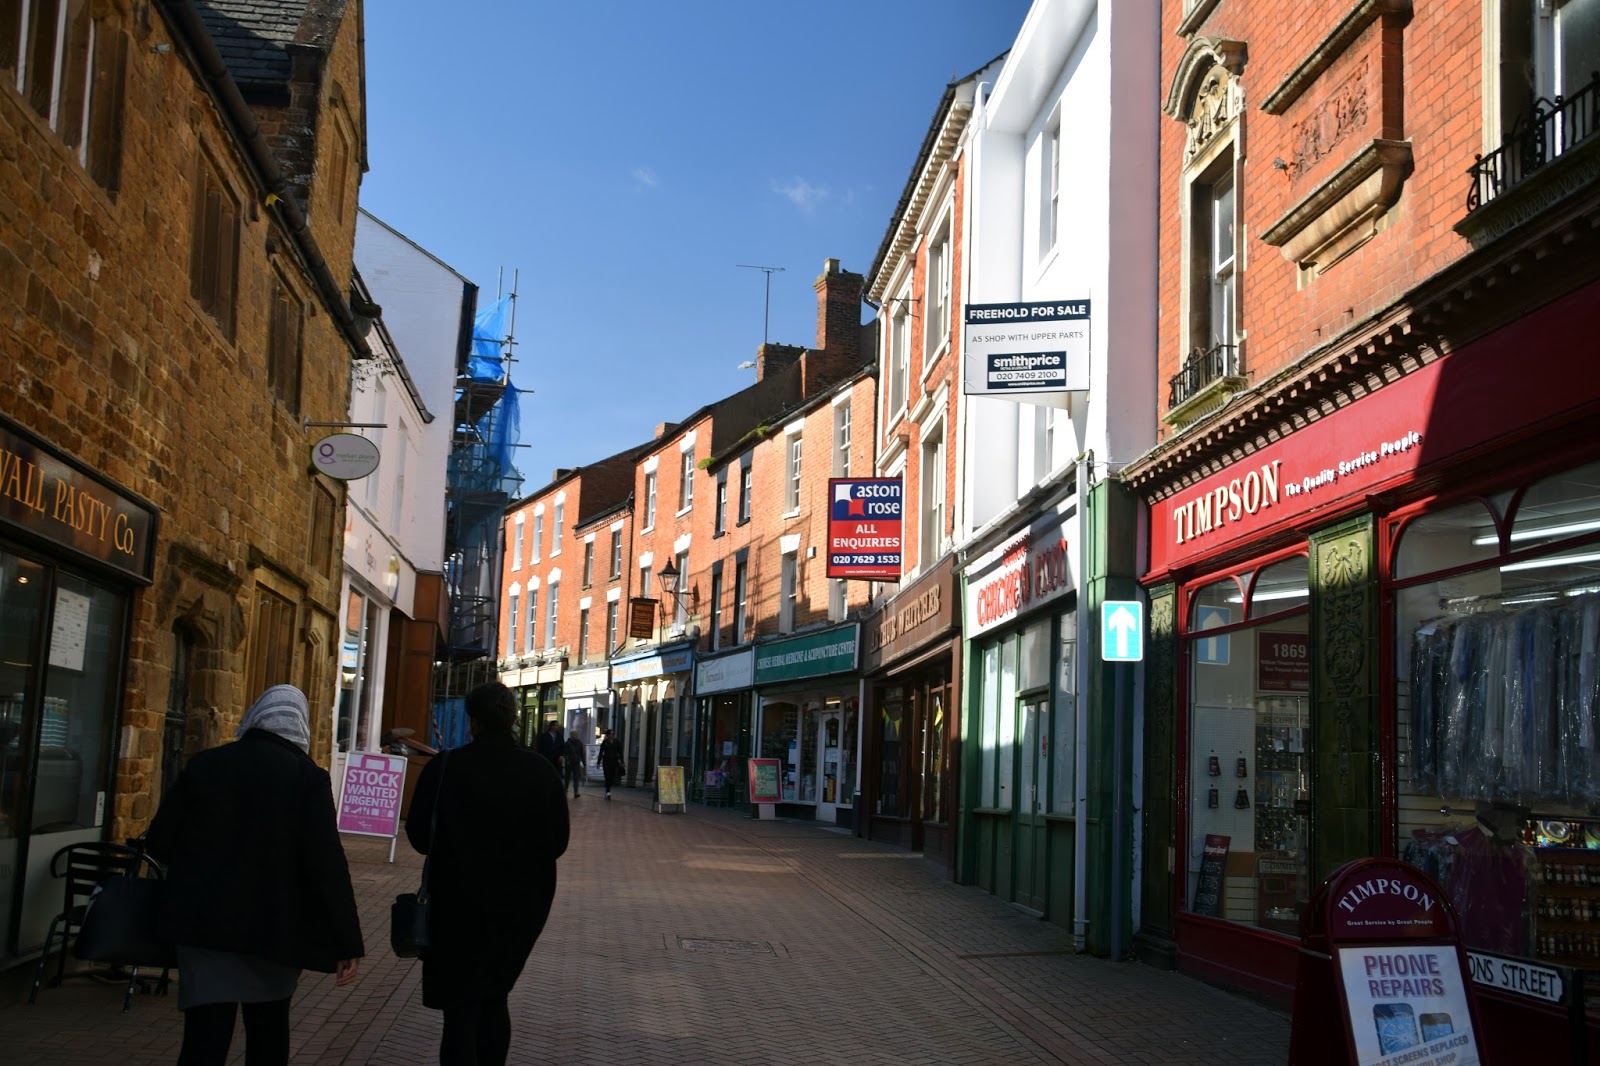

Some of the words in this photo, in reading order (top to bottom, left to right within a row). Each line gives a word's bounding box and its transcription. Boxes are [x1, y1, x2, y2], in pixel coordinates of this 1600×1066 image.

[970, 308, 1029, 320] FREEHOLD
[1031, 306, 1055, 317] FOR
[1057, 305, 1086, 316] SALE
[972, 335, 983, 343] A5
[984, 334, 1006, 342] SHOP
[1008, 333, 1029, 341] WITH
[1031, 332, 1057, 340] UPPER
[1059, 331, 1084, 339] PARTS
[994, 354, 1060, 370] smithprice
[996, 373, 1013, 381] 020
[1015, 372, 1036, 380] 7409
[1038, 371, 1058, 379] 2100
[856, 484, 900, 498] aston
[1173, 459, 1280, 544] TIMPSON
[1284, 484, 1301, 497] The
[1302, 468, 1336, 493] Quality
[1338, 452, 1378, 475] Service
[1380, 431, 1420, 454] People
[868, 502, 900, 514] rose
[52, 478, 112, 542] PASTY
[114, 513, 134, 556] Co.
[855, 524, 878, 534] ALL
[833, 537, 900, 549] ENQUIRIES
[833, 555, 850, 564] 020
[852, 555, 875, 564] 7629
[877, 555, 900, 564] 1533
[977, 560, 1031, 627] CHICKEN
[785, 650, 804, 666] MEDICINE
[808, 644, 837, 661] ACUPUNCTURE
[838, 640, 855, 656] CENTRE
[1273, 644, 1307, 658] 1869
[347, 768, 400, 788] STOCK
[346, 783, 398, 799] WANTED
[344, 795, 397, 809] URGENTLY
[1338, 878, 1436, 913] TIMPSON
[1363, 953, 1440, 978] PHONE
[1368, 977, 1445, 998] REPAIRS
[1501, 963, 1556, 997] STREET
[1392, 1047, 1429, 1066] SCREENS
[1429, 1035, 1469, 1055] REPLACED
[1435, 1052, 1457, 1066] SHOP
